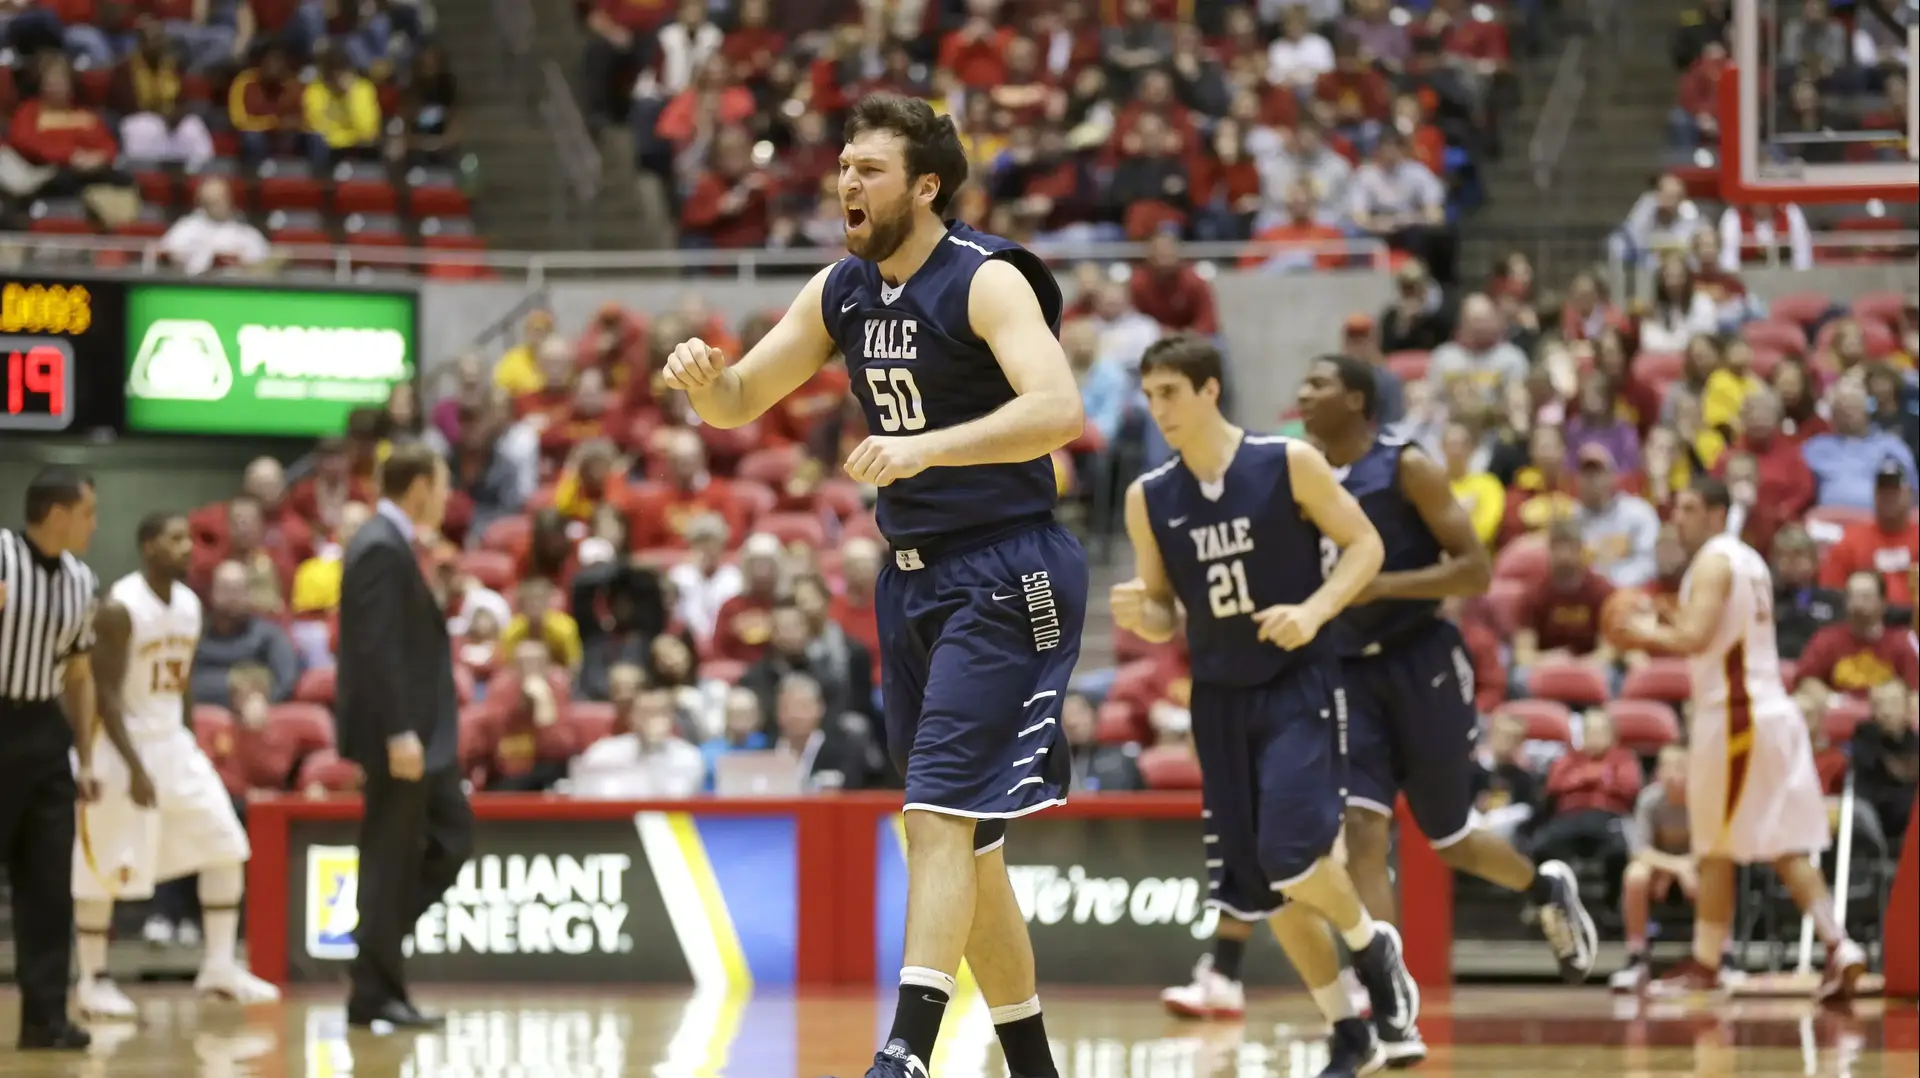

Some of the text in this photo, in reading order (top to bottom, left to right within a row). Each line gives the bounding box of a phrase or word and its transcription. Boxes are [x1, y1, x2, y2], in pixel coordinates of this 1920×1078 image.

[863, 319, 917, 360] YALE
[7, 345, 65, 416] 19
[865, 368, 926, 432] 50
[1189, 516, 1254, 562] YALE
[1021, 571, 1060, 652] BULLDOGS
[1206, 559, 1255, 618] 21
[443, 853, 631, 905] LLIANT
